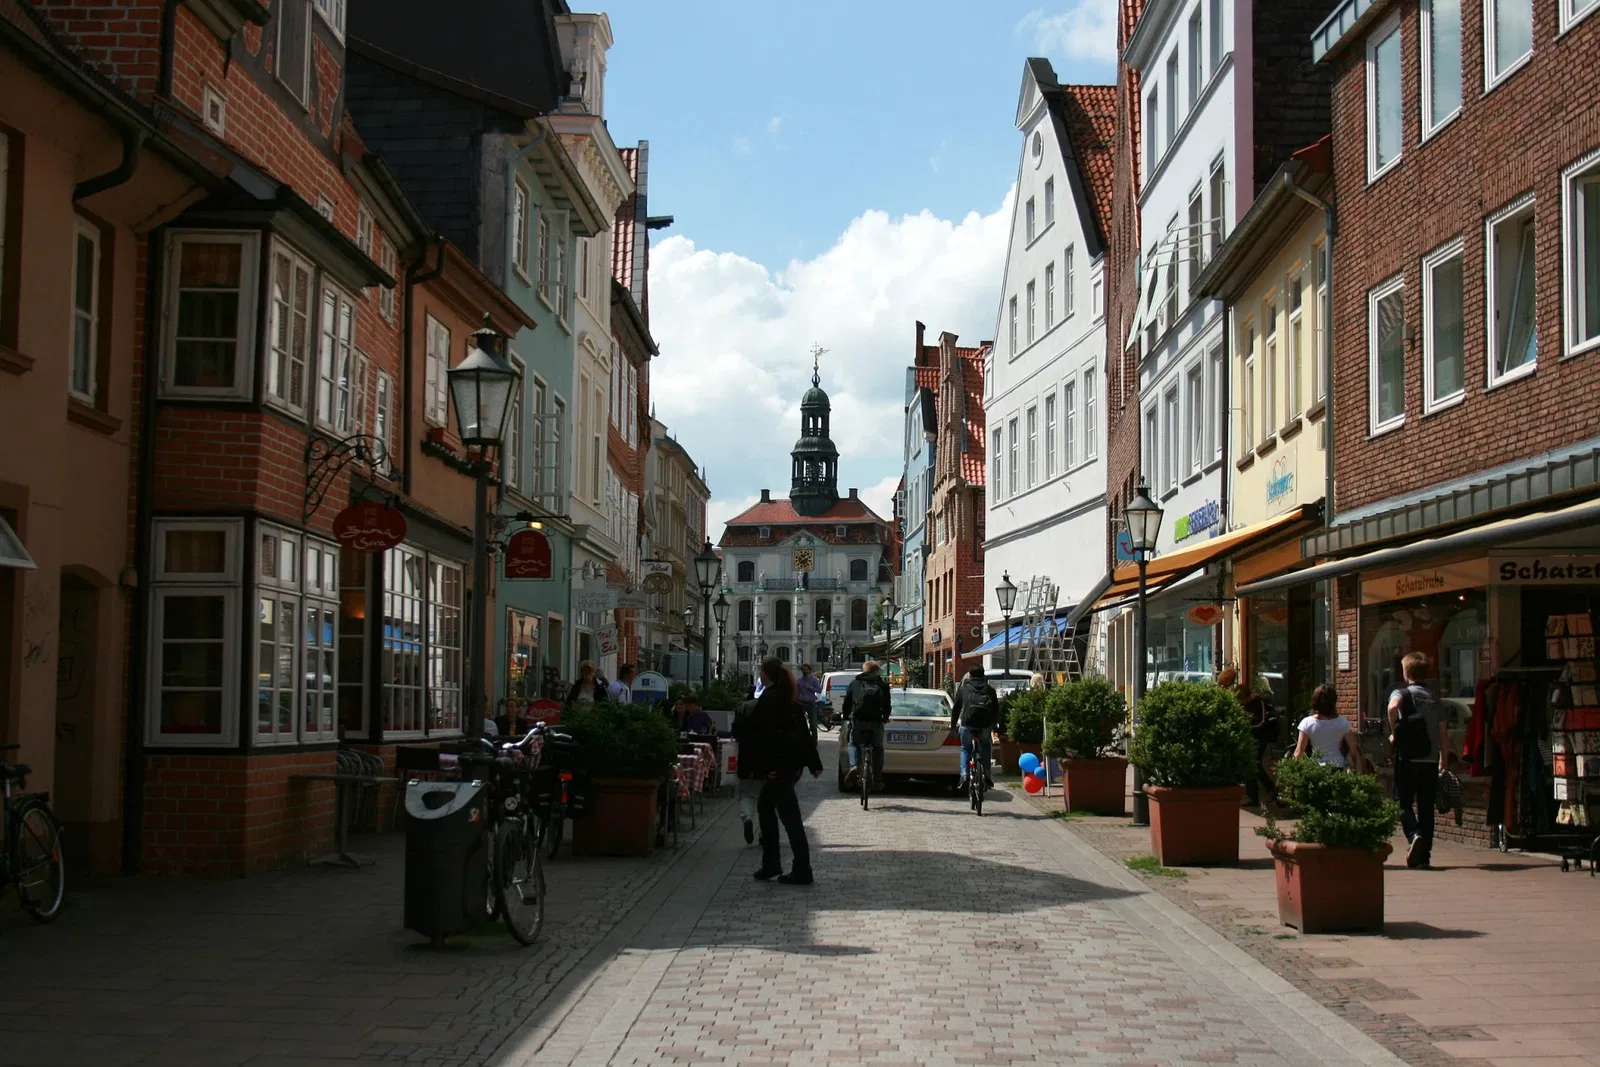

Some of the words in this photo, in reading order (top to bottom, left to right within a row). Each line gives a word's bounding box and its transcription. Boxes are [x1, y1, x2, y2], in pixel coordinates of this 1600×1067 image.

[602, 640, 617, 653] Eis
[893, 734, 903, 742] LG
[907, 734, 915, 742] RE
[916, 734, 925, 742] 36
